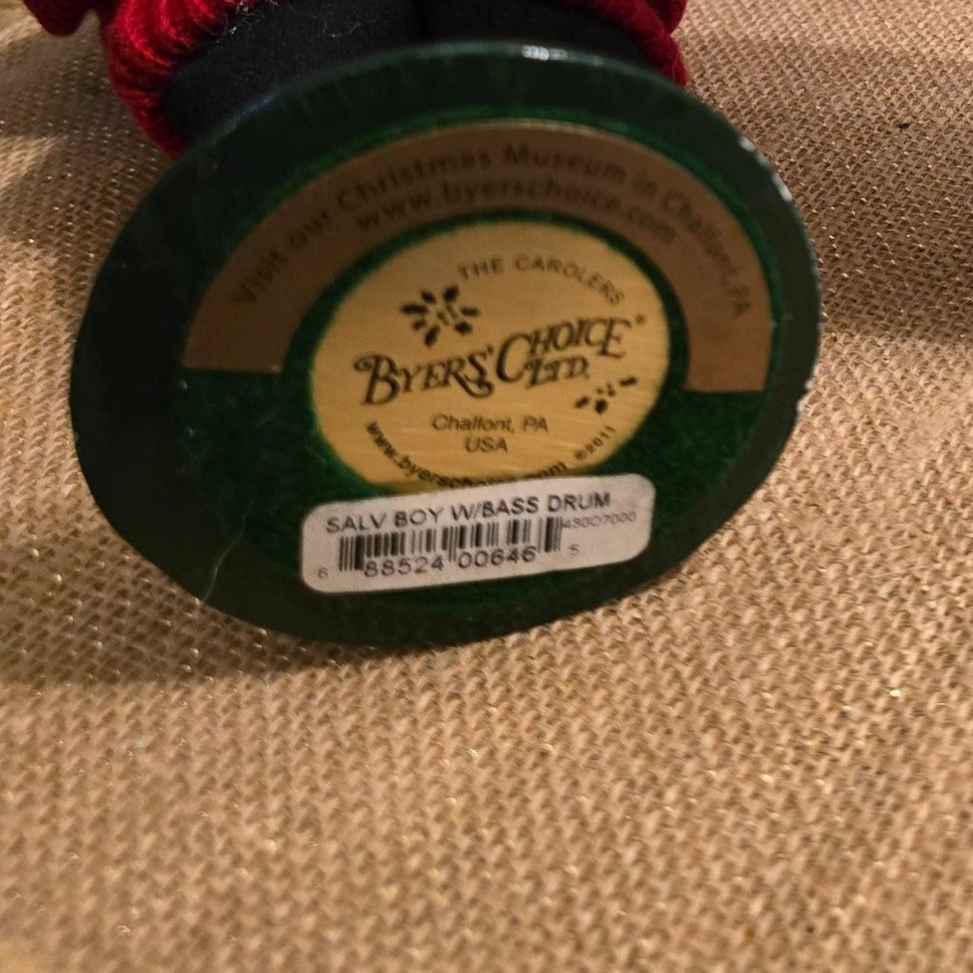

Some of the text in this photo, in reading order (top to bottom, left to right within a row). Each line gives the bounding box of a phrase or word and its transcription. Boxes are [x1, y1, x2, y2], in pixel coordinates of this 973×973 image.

[289, 209, 331, 249] our
[336, 151, 493, 212] Christmas
[504, 143, 628, 184] Museum
[457, 254, 625, 305] THE CAROLERS
[522, 415, 549, 432] PA
[465, 436, 509, 453] USA
[325, 492, 611, 533] SALV BOY W/BASS DRUM
[317, 543, 580, 579] 6 88524 00646 5
